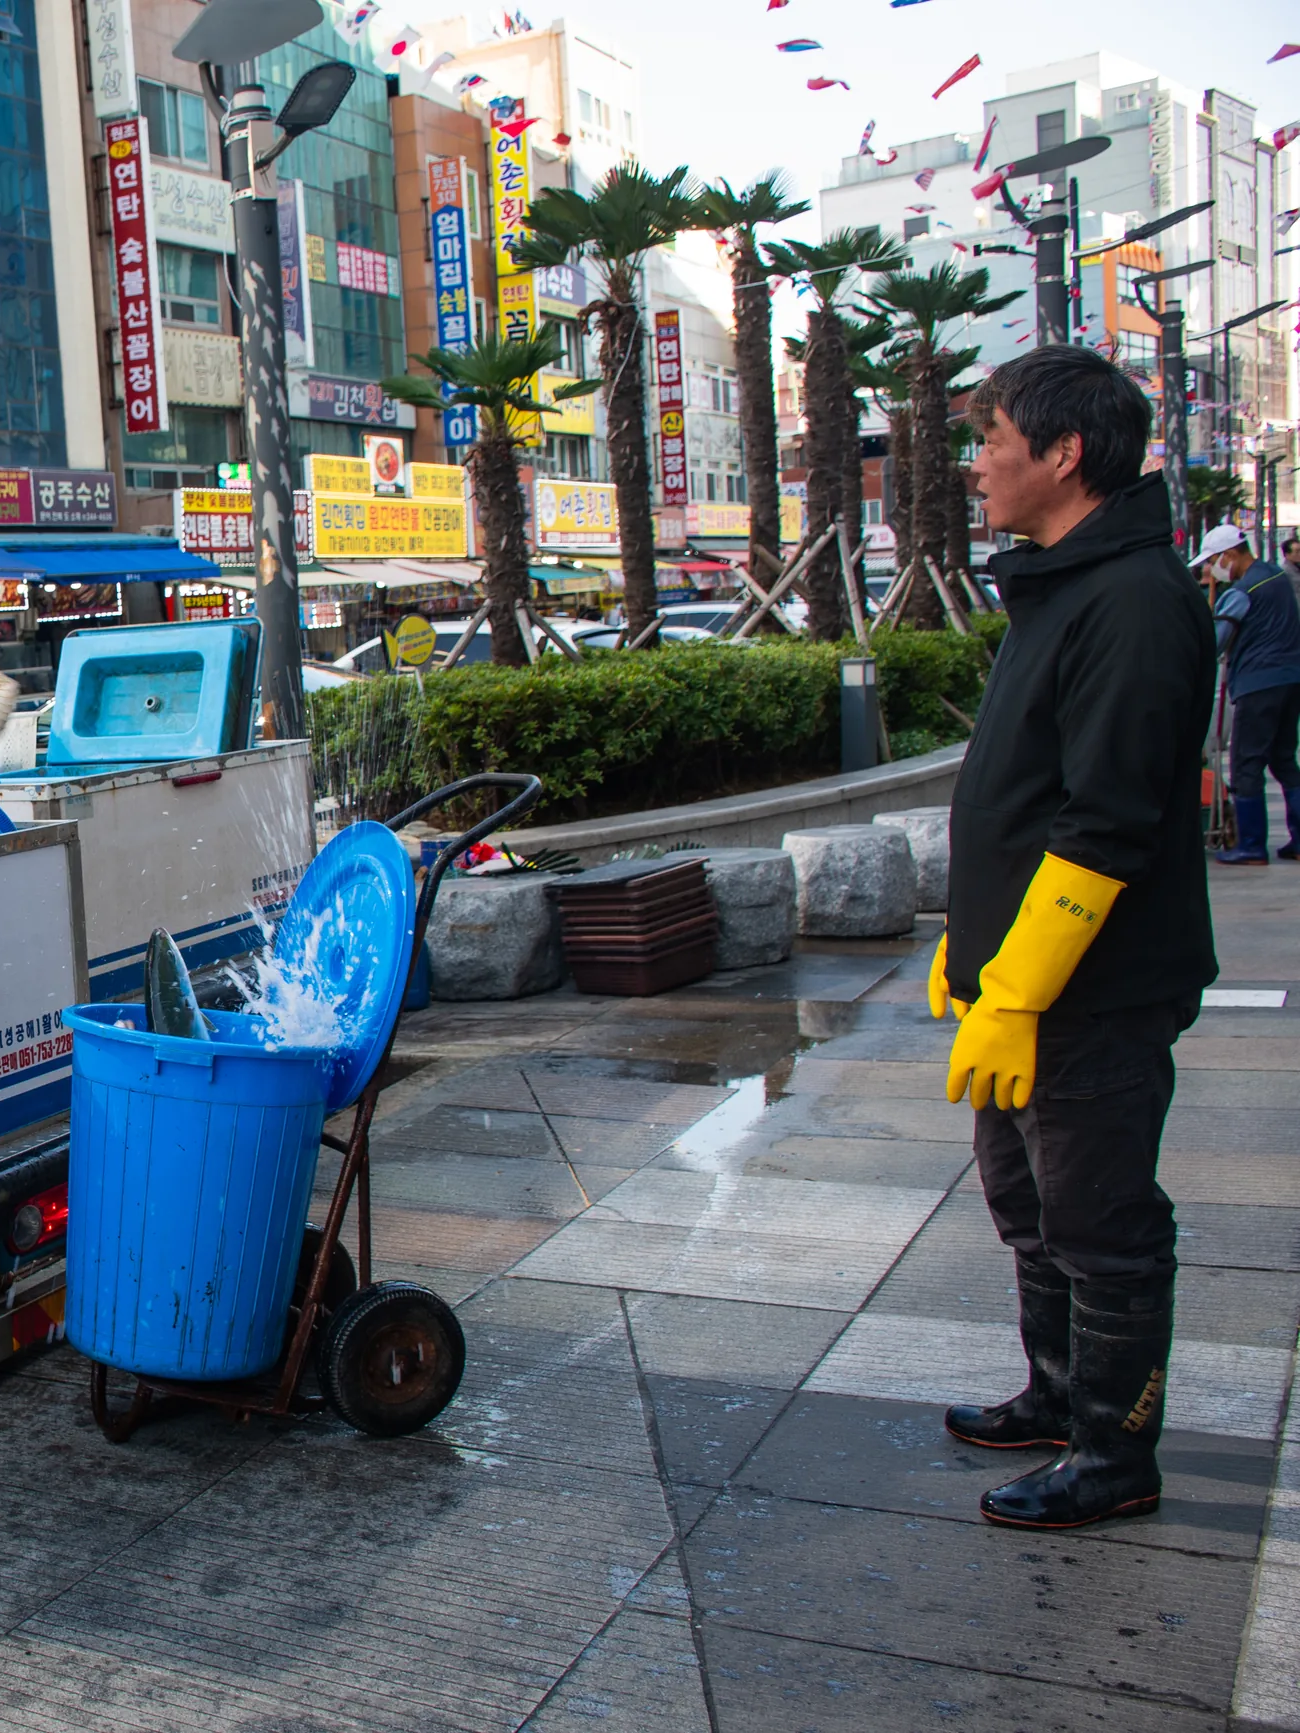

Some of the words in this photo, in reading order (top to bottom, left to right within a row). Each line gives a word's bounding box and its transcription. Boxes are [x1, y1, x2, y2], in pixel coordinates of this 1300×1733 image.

[437, 211, 463, 286] 엄마집
[39, 480, 110, 509] 공주수산
[19, 1032, 74, 1068] 051-753-228
